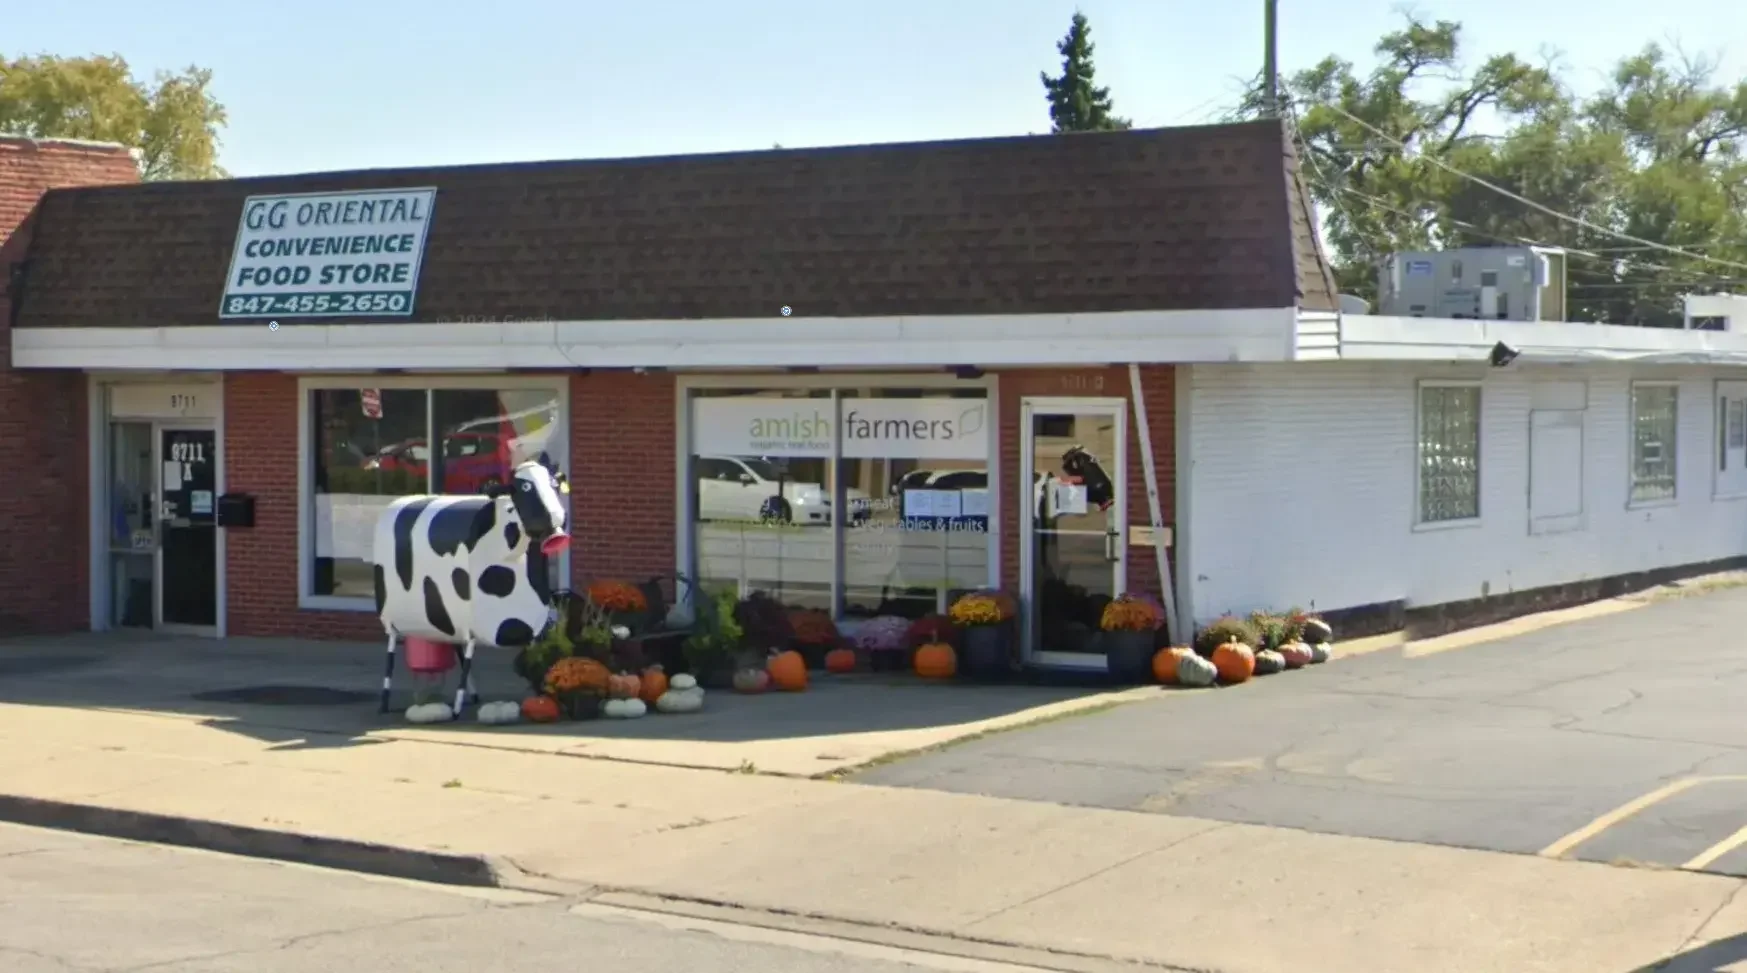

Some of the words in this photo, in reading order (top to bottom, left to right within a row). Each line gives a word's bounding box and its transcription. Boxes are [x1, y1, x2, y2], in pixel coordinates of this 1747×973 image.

[246, 200, 288, 230] GG
[296, 197, 423, 226] ORIENTAL
[245, 233, 415, 258] CONVENIENCE
[237, 265, 311, 287] FOOD
[319, 262, 410, 285] STORE
[229, 294, 405, 313] 847-455-2650
[749, 410, 830, 439] amish
[846, 411, 954, 440] farmers
[860, 516, 932, 535] vegtables
